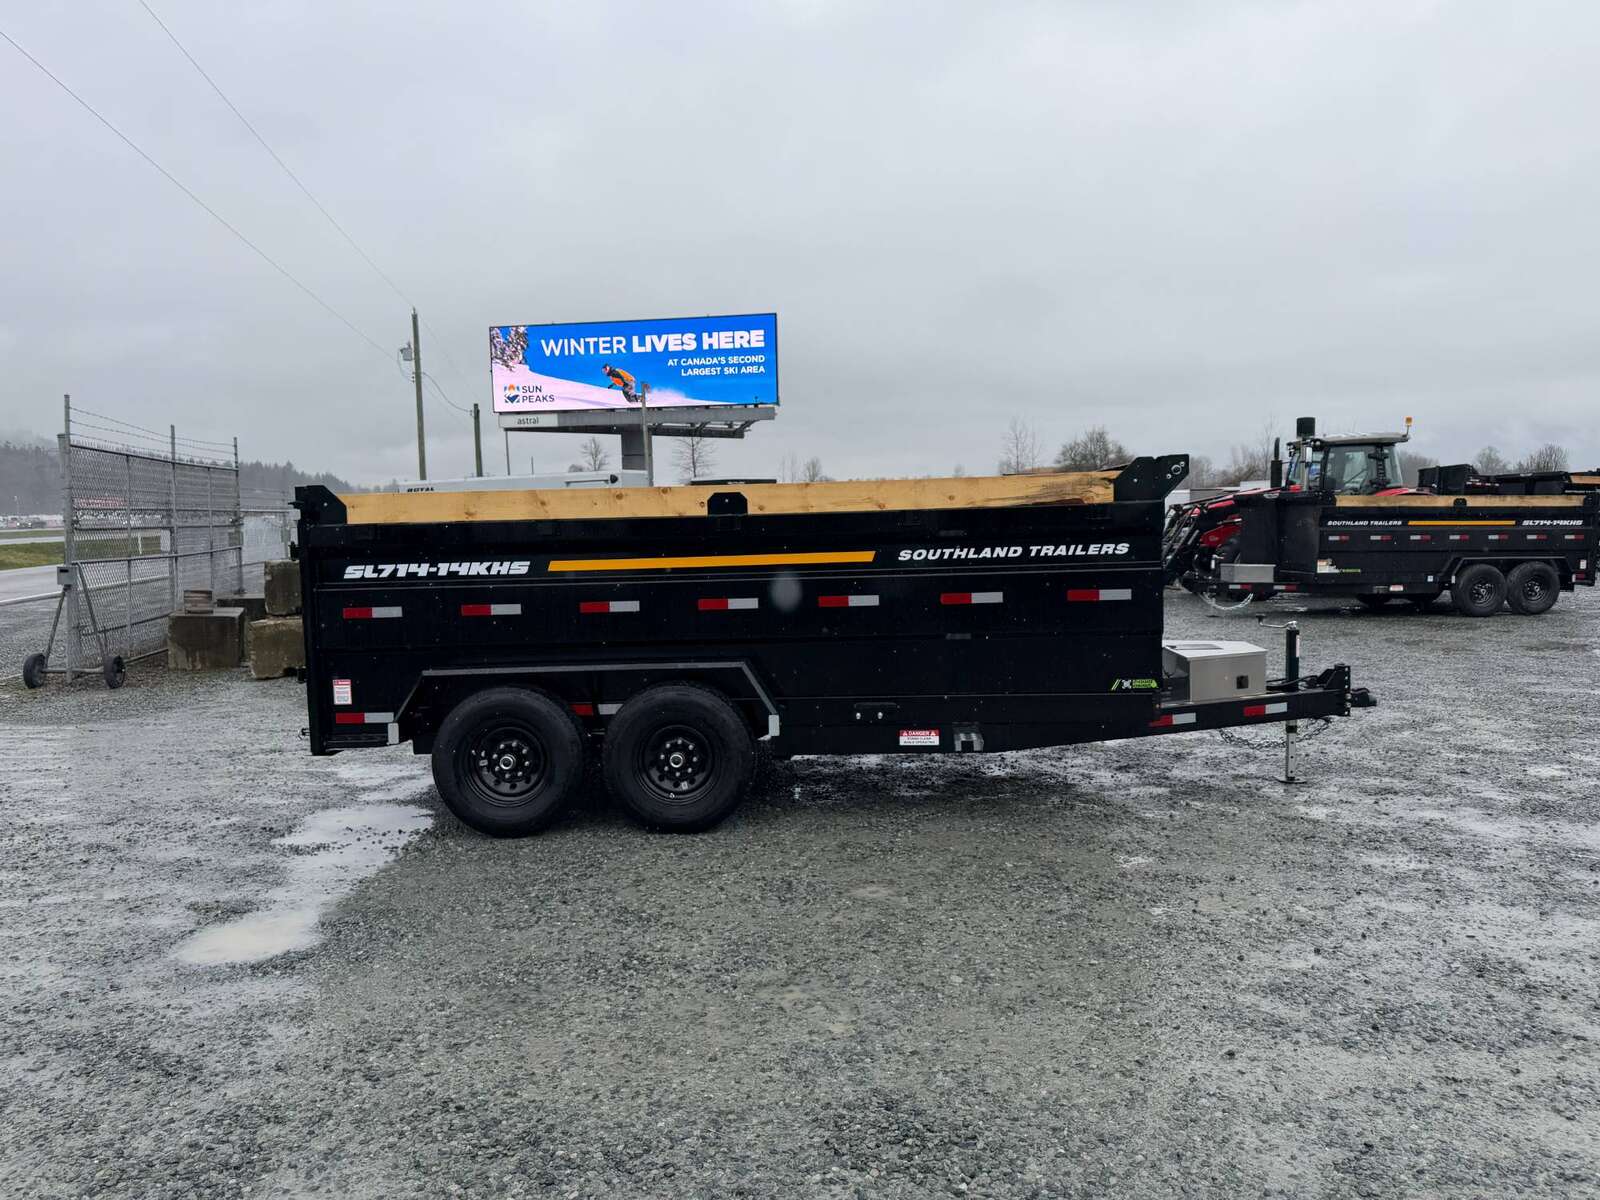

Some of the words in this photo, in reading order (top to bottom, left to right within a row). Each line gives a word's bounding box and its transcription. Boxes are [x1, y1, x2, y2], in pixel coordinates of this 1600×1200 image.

[540, 336, 627, 357] WINTER
[632, 333, 697, 353] LIVES
[702, 329, 765, 350] HERE
[667, 358, 679, 367] AT
[680, 356, 726, 366] CANADA'S
[728, 354, 765, 364] SECOND
[681, 366, 721, 377] LARGEST
[723, 366, 738, 375] SKI
[740, 365, 766, 374] AREA
[521, 385, 542, 394] SUN
[521, 394, 555, 403] PEAKS
[517, 416, 539, 425] astral
[898, 546, 1023, 561] SOUTHLAND
[1029, 543, 1130, 557] TRAILERS
[343, 561, 531, 579] SL714-14KHS
